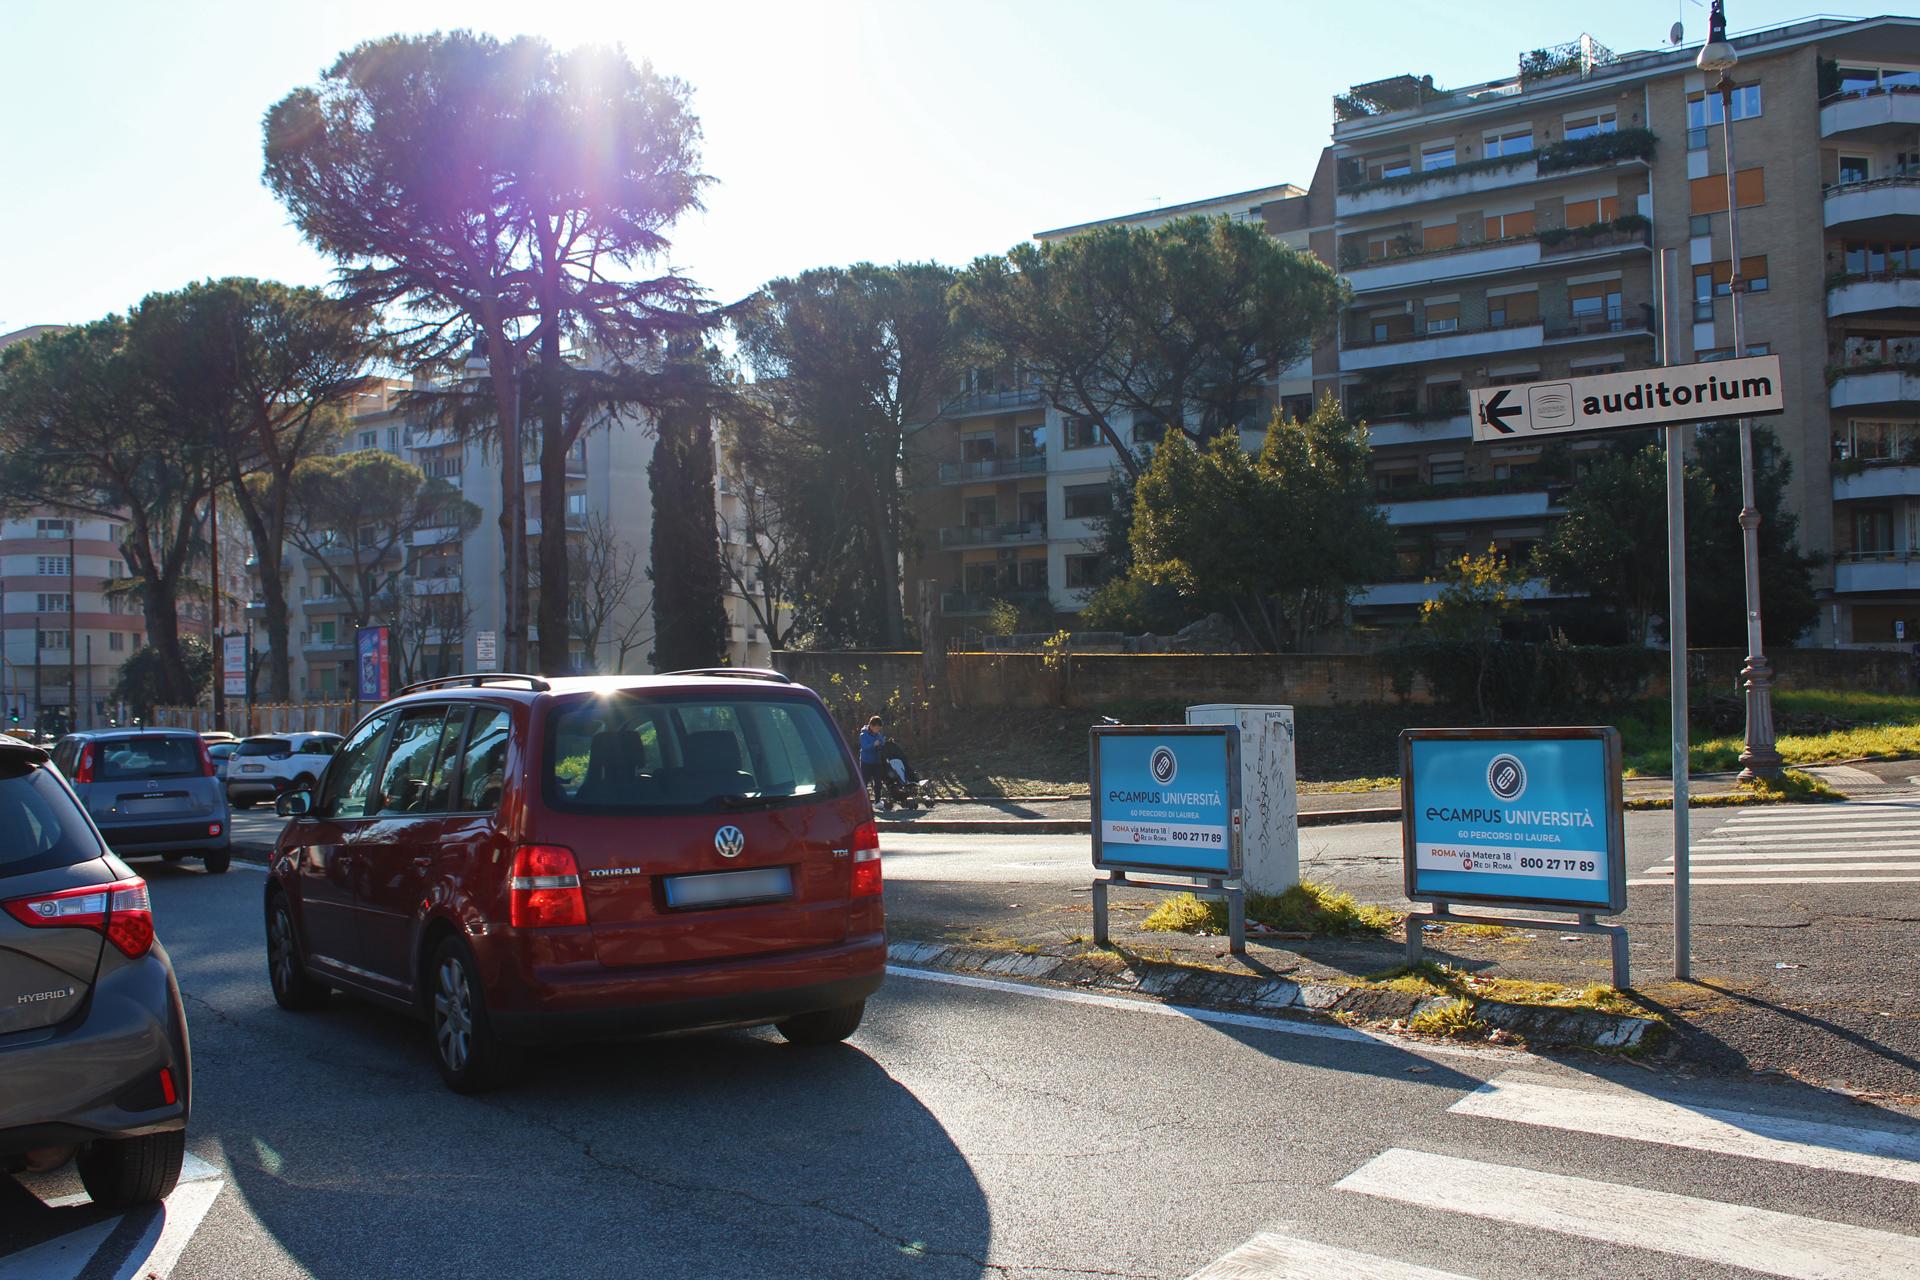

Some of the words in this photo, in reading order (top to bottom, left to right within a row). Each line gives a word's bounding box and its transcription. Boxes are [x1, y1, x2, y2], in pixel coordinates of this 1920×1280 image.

[1583, 376, 1772, 415] auditorium
[1162, 790, 1221, 806] UNIVERSITÀ
[1130, 809, 1138, 817] 60
[1138, 810, 1167, 818] PERCORSI
[1176, 811, 1200, 819] LAUREA
[1505, 808, 1594, 828] UNIVERSITÀ
[1172, 832, 1188, 841] 800
[1190, 832, 1199, 841] 27
[1201, 833, 1210, 842] 17
[1212, 834, 1222, 843] 89
[1458, 830, 1469, 838] 60
[1470, 831, 1512, 840] PERCORSI
[1525, 833, 1561, 842] LAUREA
[1431, 849, 1457, 857] ROMA
[1459, 850, 1470, 858] via
[1472, 851, 1501, 860] Matera
[1503, 852, 1512, 861] 18
[1520, 857, 1543, 869] 800
[1547, 859, 1561, 870] 27
[1564, 860, 1576, 870] 17
[1579, 860, 1595, 872] 89
[589, 867, 640, 877] TOURAN
[17, 989, 67, 1004] HYBRID
